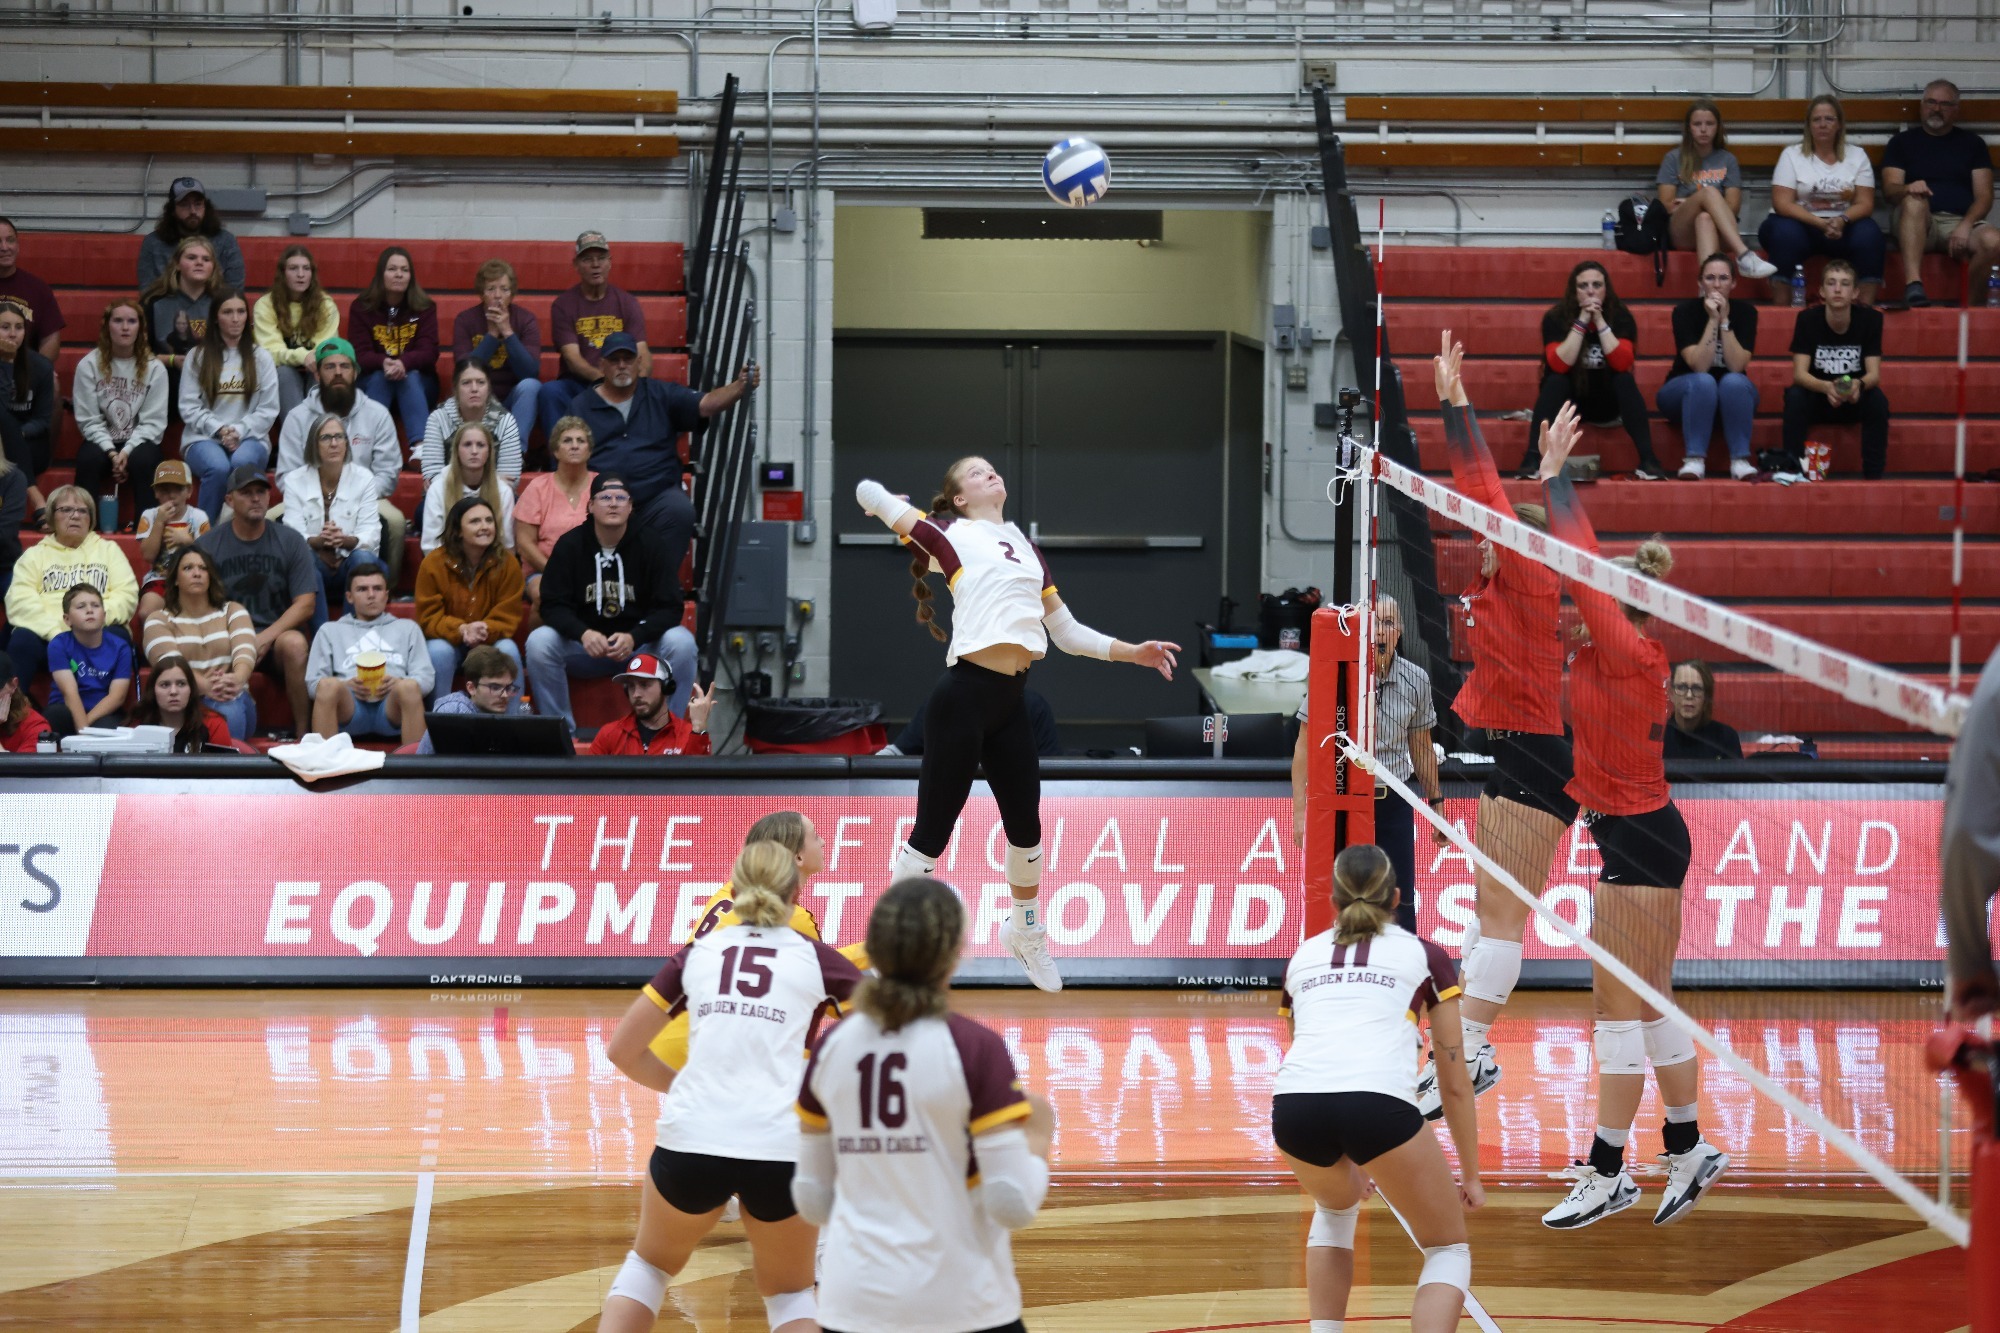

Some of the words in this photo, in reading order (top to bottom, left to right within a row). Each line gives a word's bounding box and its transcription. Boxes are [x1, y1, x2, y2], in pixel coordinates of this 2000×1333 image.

[998, 541, 1021, 564] 2
[534, 815, 702, 871] THE
[829, 816, 1184, 873] FFICIAL
[1715, 820, 1901, 875] AND
[0, 843, 61, 913] S
[264, 880, 864, 957] EQUIPMET
[1705, 885, 1889, 948] THE
[430, 974, 523, 984] DAKTRONICS
[718, 945, 778, 999] 15
[1177, 976, 1269, 986] DAKTRONICS
[1301, 972, 1343, 993] GOLDEN
[1347, 972, 1396, 990] EAGLES
[698, 1001, 738, 1018] GOLDEN
[741, 1003, 787, 1023] EAGLES
[856, 1052, 908, 1129] 16
